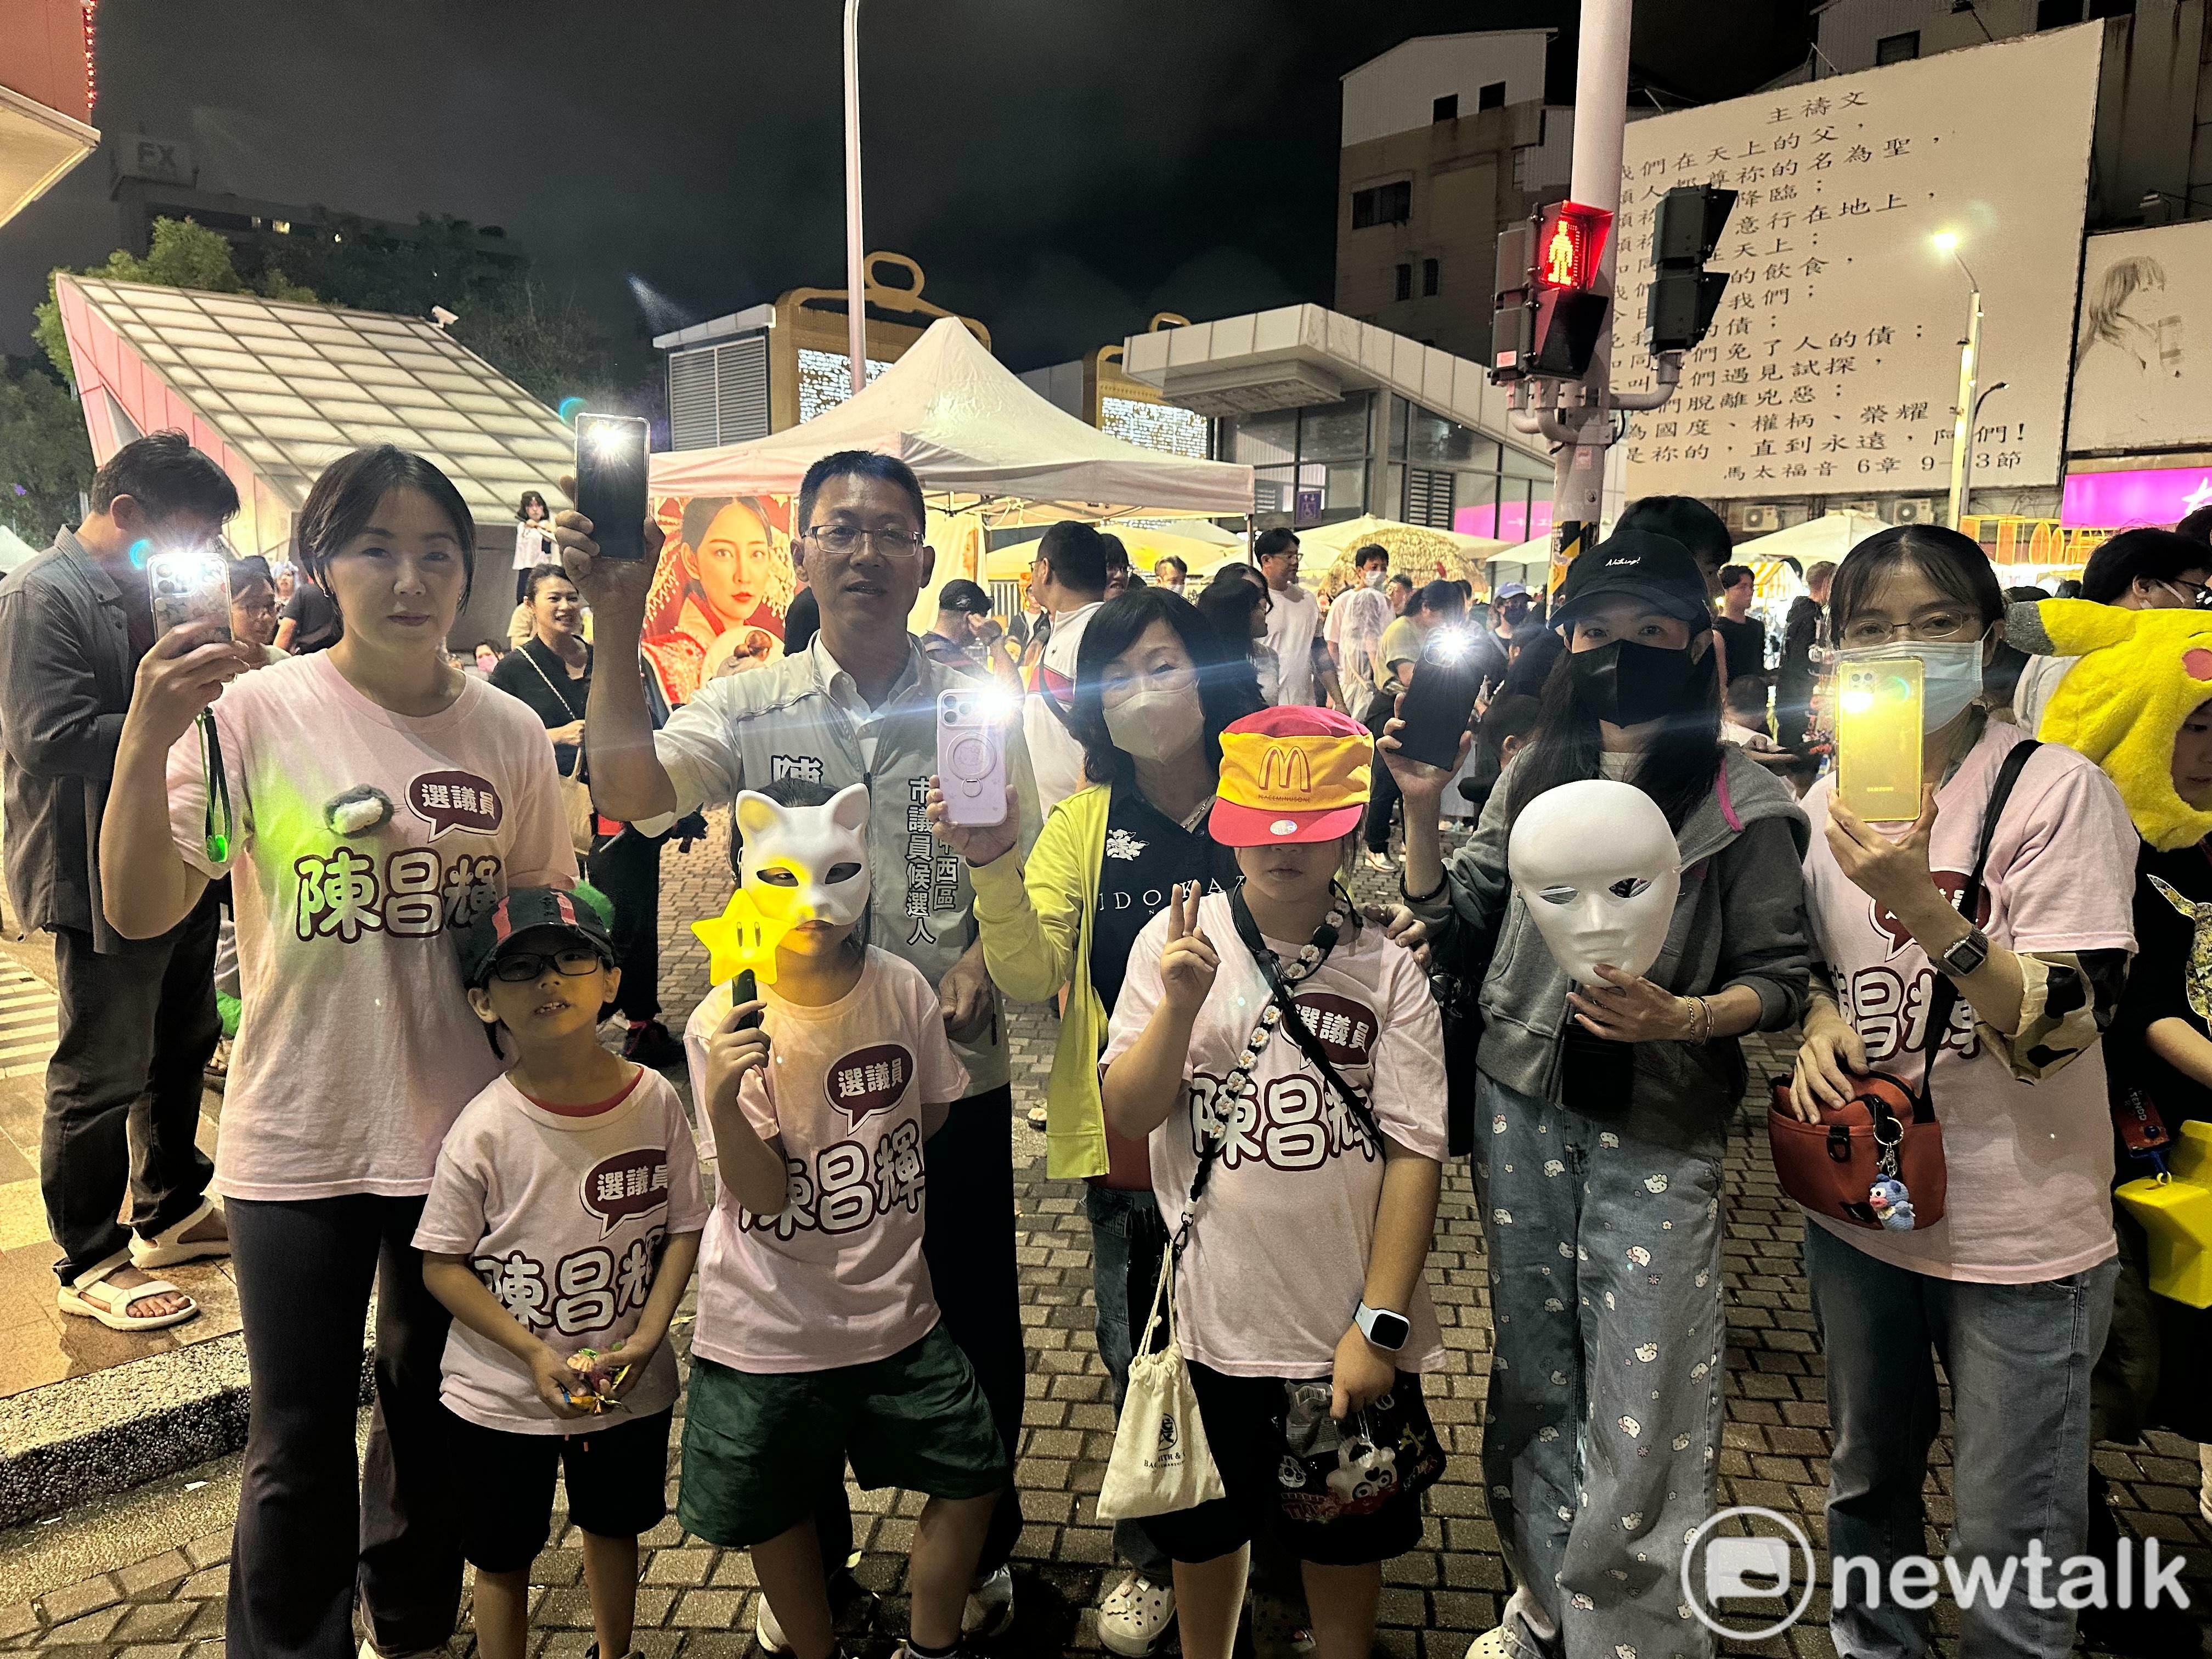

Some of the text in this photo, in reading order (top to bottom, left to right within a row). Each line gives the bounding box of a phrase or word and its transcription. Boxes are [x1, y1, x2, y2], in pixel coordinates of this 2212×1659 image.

[1766, 92, 1869, 125] 主禱文
[1727, 461, 1838, 481] 馬太福音
[1857, 456, 1901, 474] 6章
[421, 783, 495, 820] 選議員
[906, 776, 934, 945] 市議員候選人
[294, 847, 500, 944] 陳昌輝
[1295, 1005, 1371, 1050] 選議員
[838, 1058, 903, 1098] 選議員
[597, 1164, 668, 1202] 選議員
